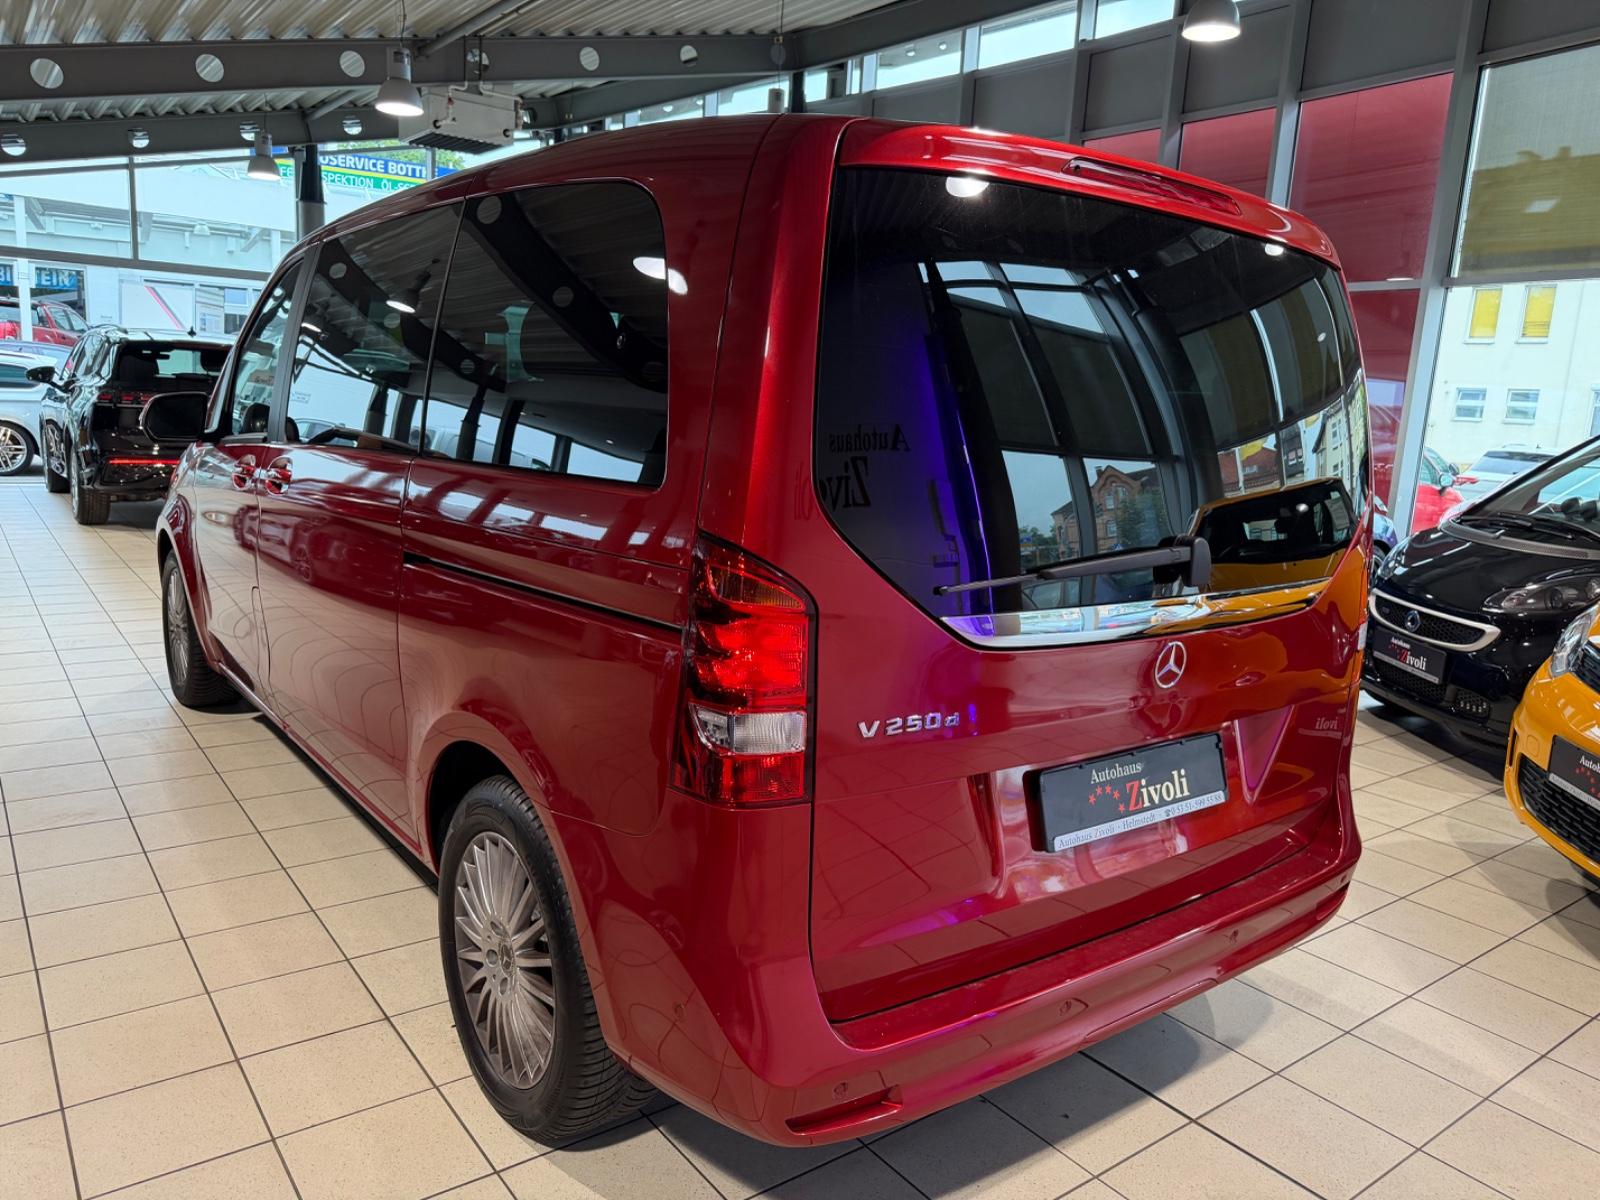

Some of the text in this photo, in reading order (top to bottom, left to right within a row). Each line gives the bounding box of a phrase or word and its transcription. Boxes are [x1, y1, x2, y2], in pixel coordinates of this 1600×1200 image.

[1399, 648, 1428, 672] Zivoli
[858, 720, 880, 738] V
[1090, 762, 1142, 785] Autohaus
[1126, 768, 1190, 812] Zivoli
[1058, 834, 1092, 849] Autohaus
[1094, 825, 1115, 839] Zivoli
[1122, 813, 1156, 830] Helmstedt
